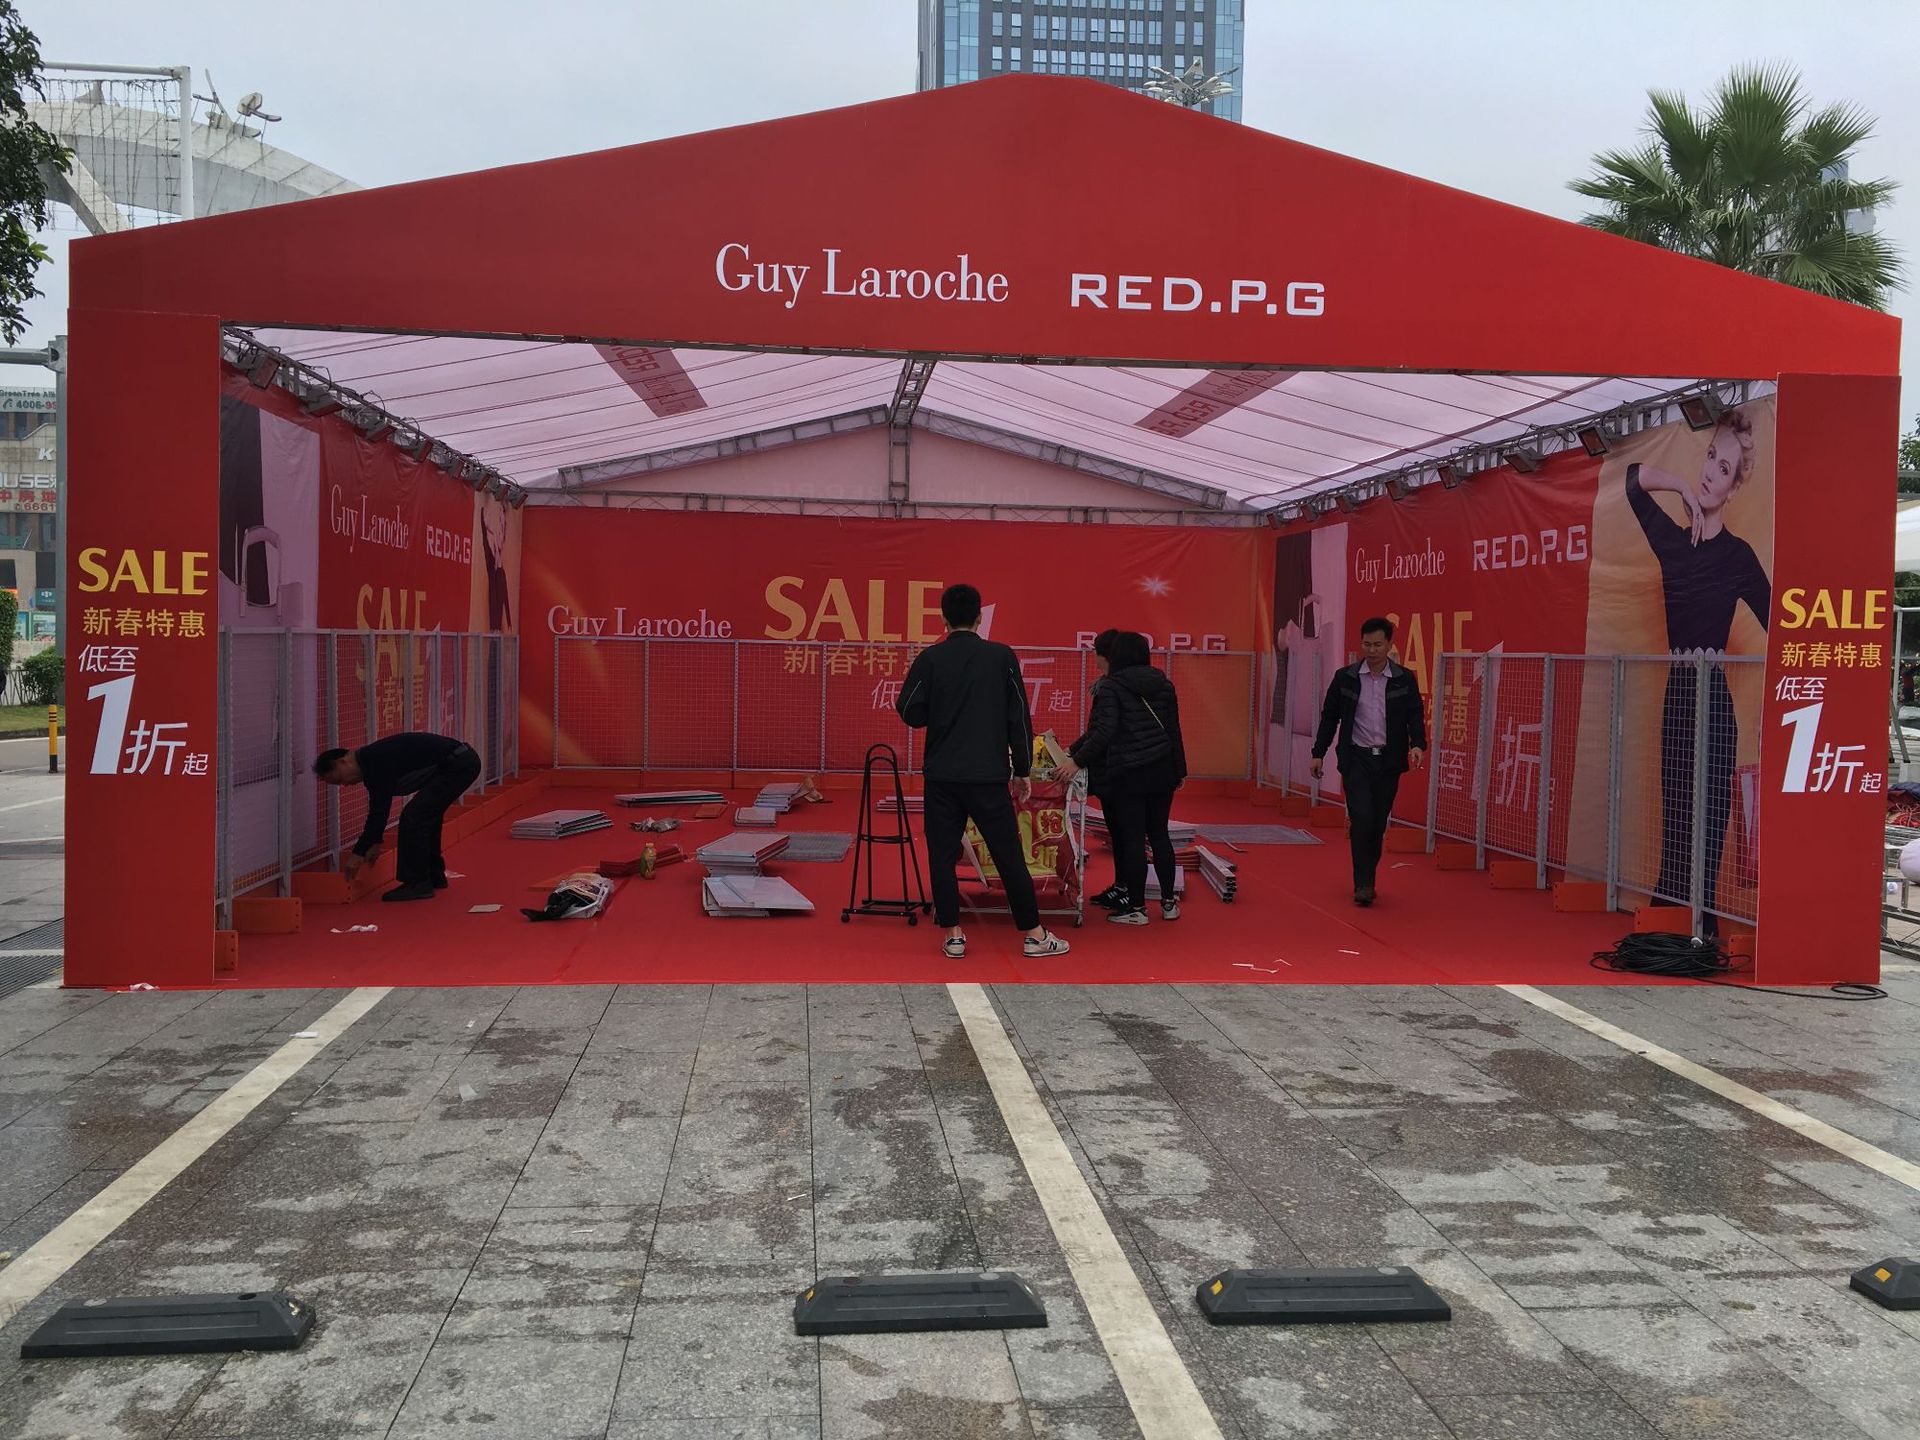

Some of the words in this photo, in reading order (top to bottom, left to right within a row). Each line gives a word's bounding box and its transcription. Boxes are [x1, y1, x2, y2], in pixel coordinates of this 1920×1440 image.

[715, 243, 810, 309] Guy
[822, 249, 1010, 303] Laroche
[1071, 273, 1326, 317] RED.P.G
[331, 484, 359, 553] Guy
[360, 494, 410, 550] Laroche
[426, 524, 472, 565] RED.P.G
[1355, 547, 1379, 593] Guy
[1383, 537, 1446, 581] Laroche
[1473, 524, 1588, 572] RED.P.G
[78, 547, 209, 596] SALE
[83, 606, 206, 638] 新春特惠
[547, 605, 608, 646] Guy
[614, 607, 733, 639] Laroche
[764, 575, 948, 644] SALE
[1780, 587, 1888, 630] SALE
[78, 643, 140, 674] 低至
[783, 638, 919, 677] 新春特
[1076, 631, 1226, 652] R.P.G
[1781, 641, 1883, 669] 新春特惠
[1775, 675, 1828, 702] 低至
